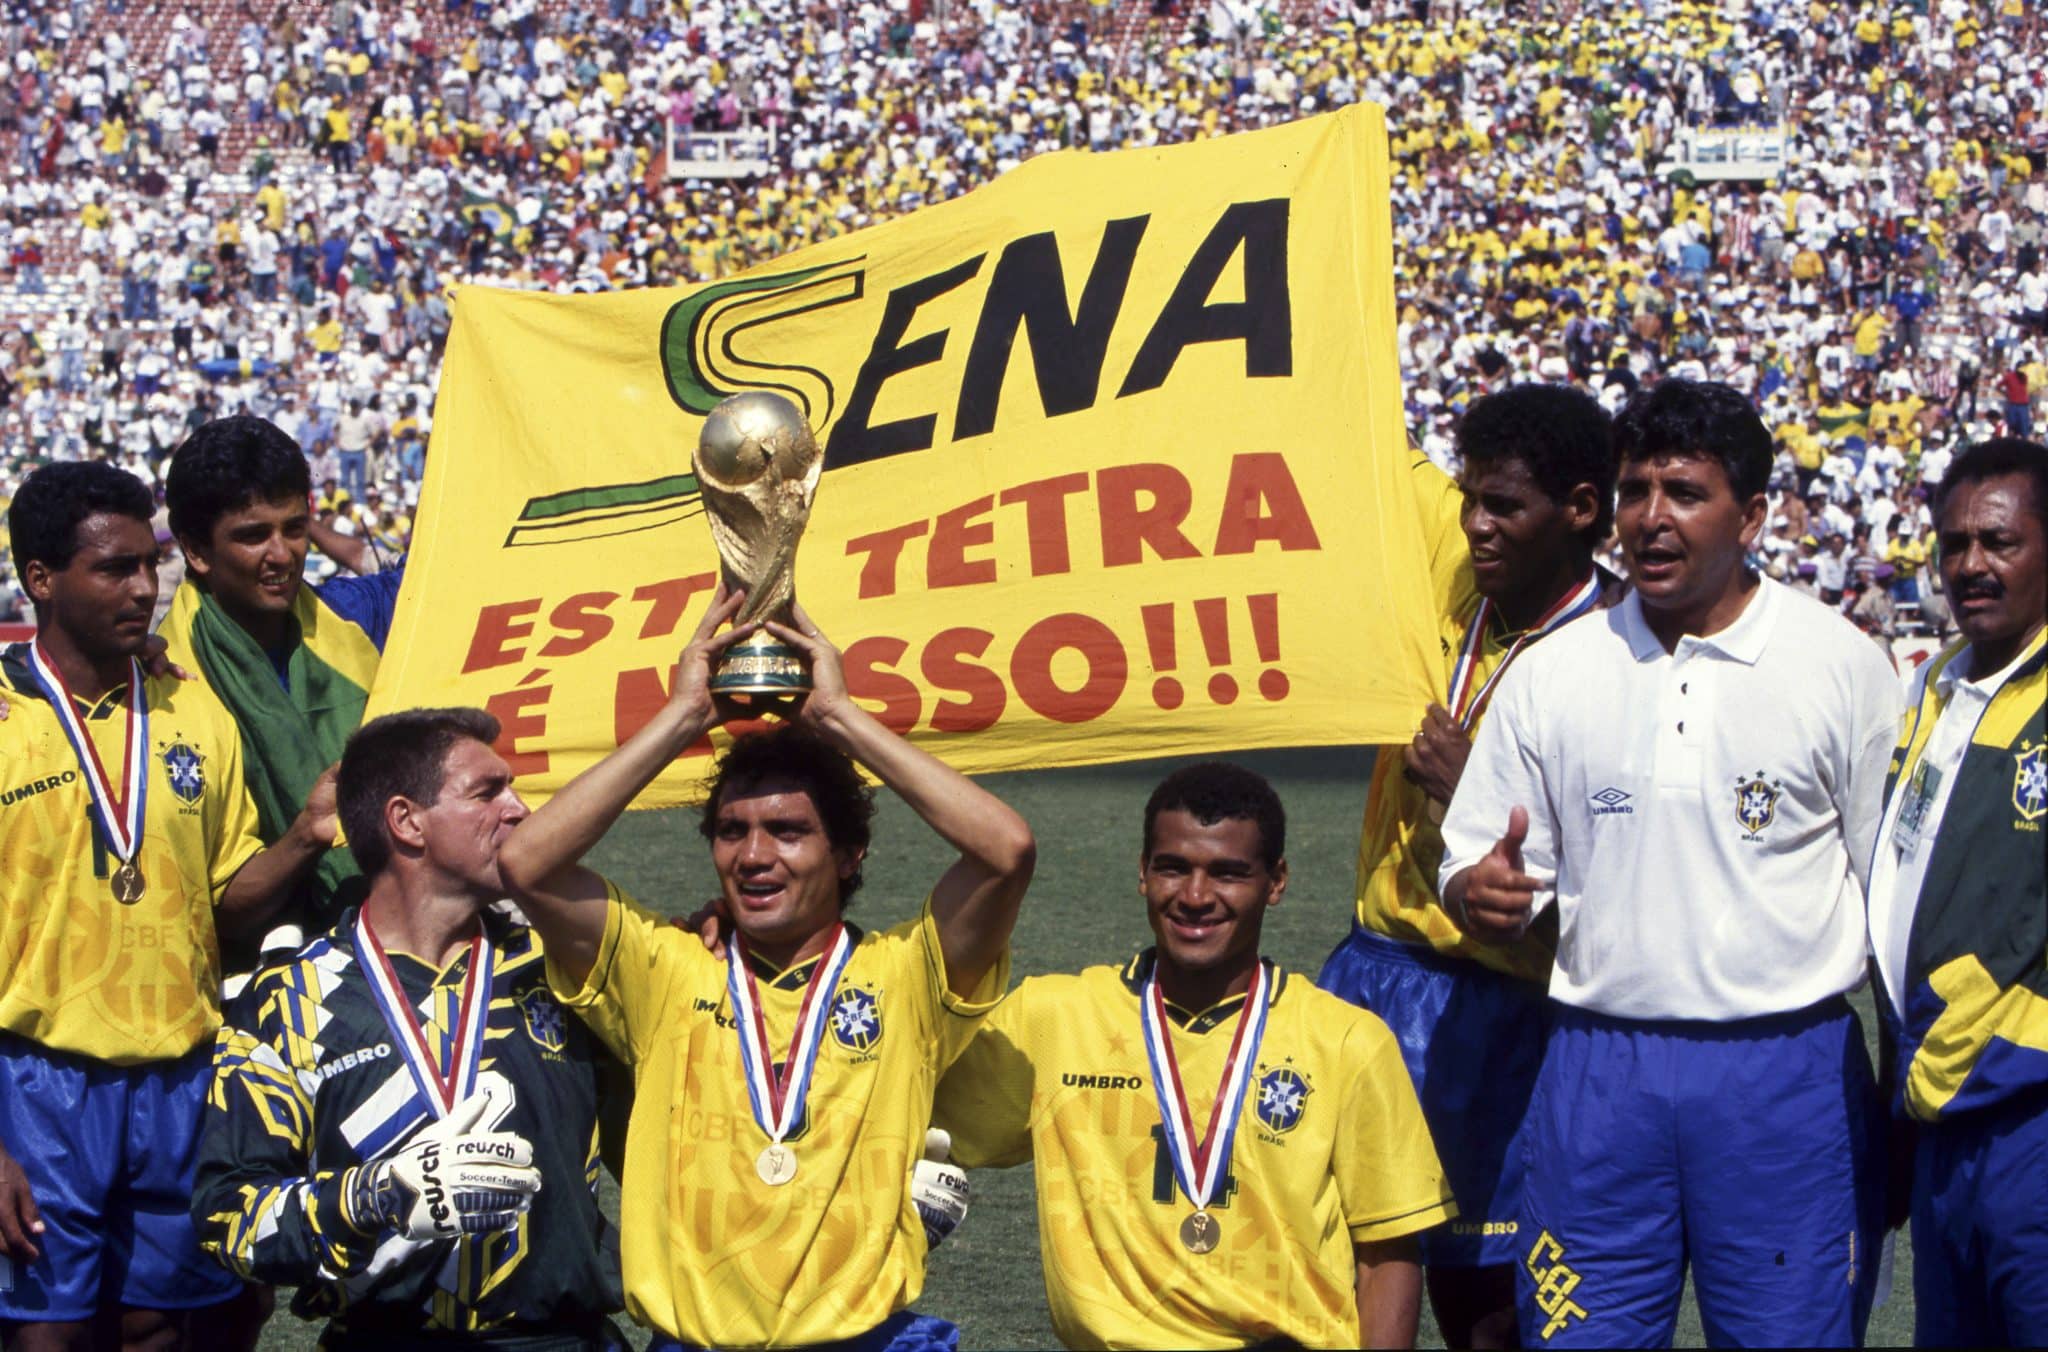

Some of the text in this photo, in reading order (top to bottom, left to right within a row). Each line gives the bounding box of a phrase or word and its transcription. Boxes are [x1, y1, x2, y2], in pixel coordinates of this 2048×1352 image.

[504, 198, 1292, 548] SENA
[461, 452, 1322, 674] EST TETRA
[614, 593, 1291, 760] NSSO!!!
[0, 770, 76, 806] UMBRO
[121, 924, 174, 949] CBF
[1062, 1072, 1142, 1090] UMBRO
[457, 1142, 515, 1161] reusch
[417, 1142, 456, 1232] reusch
[459, 1172, 528, 1187] Soccer-Team
[1452, 1221, 1519, 1236] UMBRO
[1527, 1228, 1588, 1340] CBF
